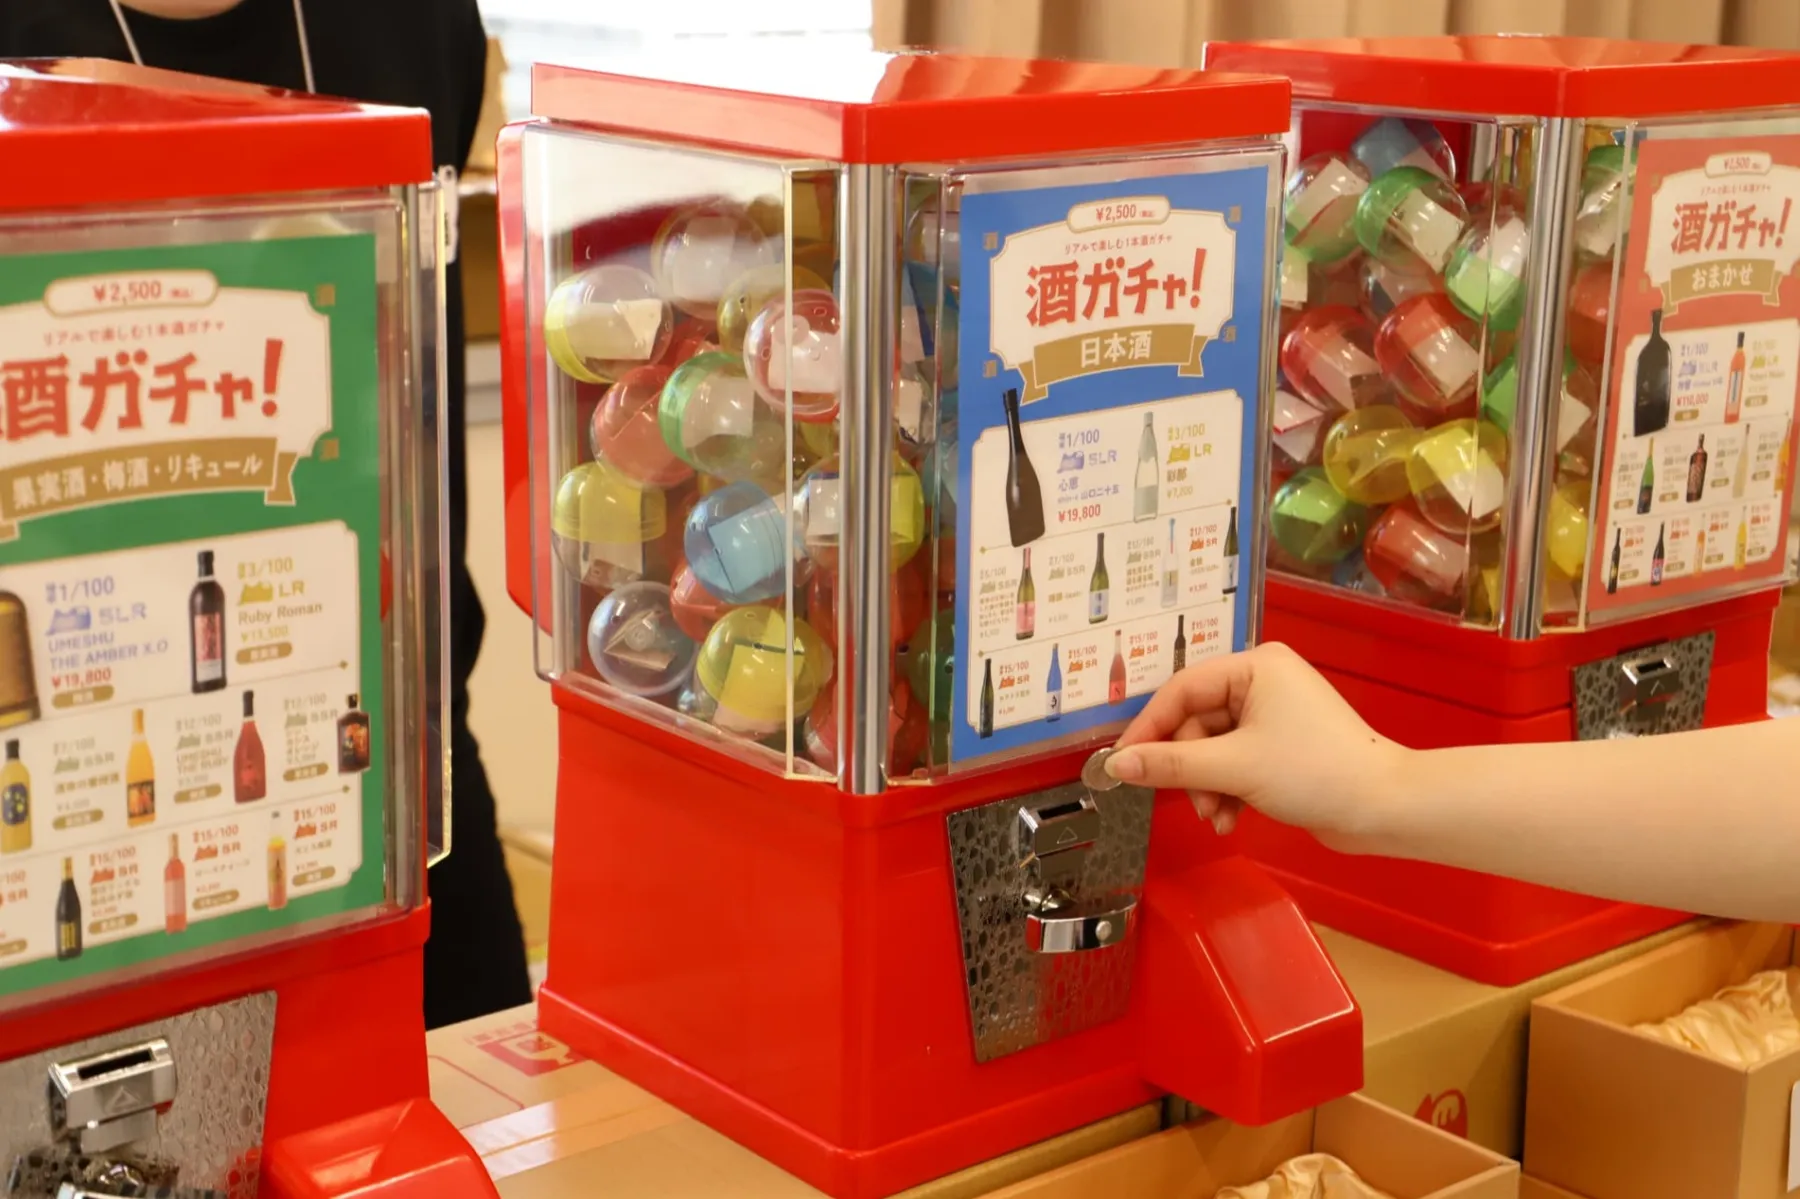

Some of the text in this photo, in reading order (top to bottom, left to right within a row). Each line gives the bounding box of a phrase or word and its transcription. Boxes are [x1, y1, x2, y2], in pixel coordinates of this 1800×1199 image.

[1096, 204, 1137, 223] ¥2,500
[1692, 263, 1753, 292] おまかせ
[93, 280, 162, 305] ¥2,500
[1080, 330, 1153, 368] 日本酒
[1088, 449, 1117, 467] SLR
[1194, 443, 1212, 457] LR
[1058, 504, 1101, 523] ¥19,800
[279, 580, 305, 598] LR
[239, 603, 322, 626] Ruby Roman
[49, 632, 114, 653] UMESHU
[51, 654, 80, 671] THE
[85, 644, 138, 665] AMBER
[52, 666, 112, 690] ¥19,800
